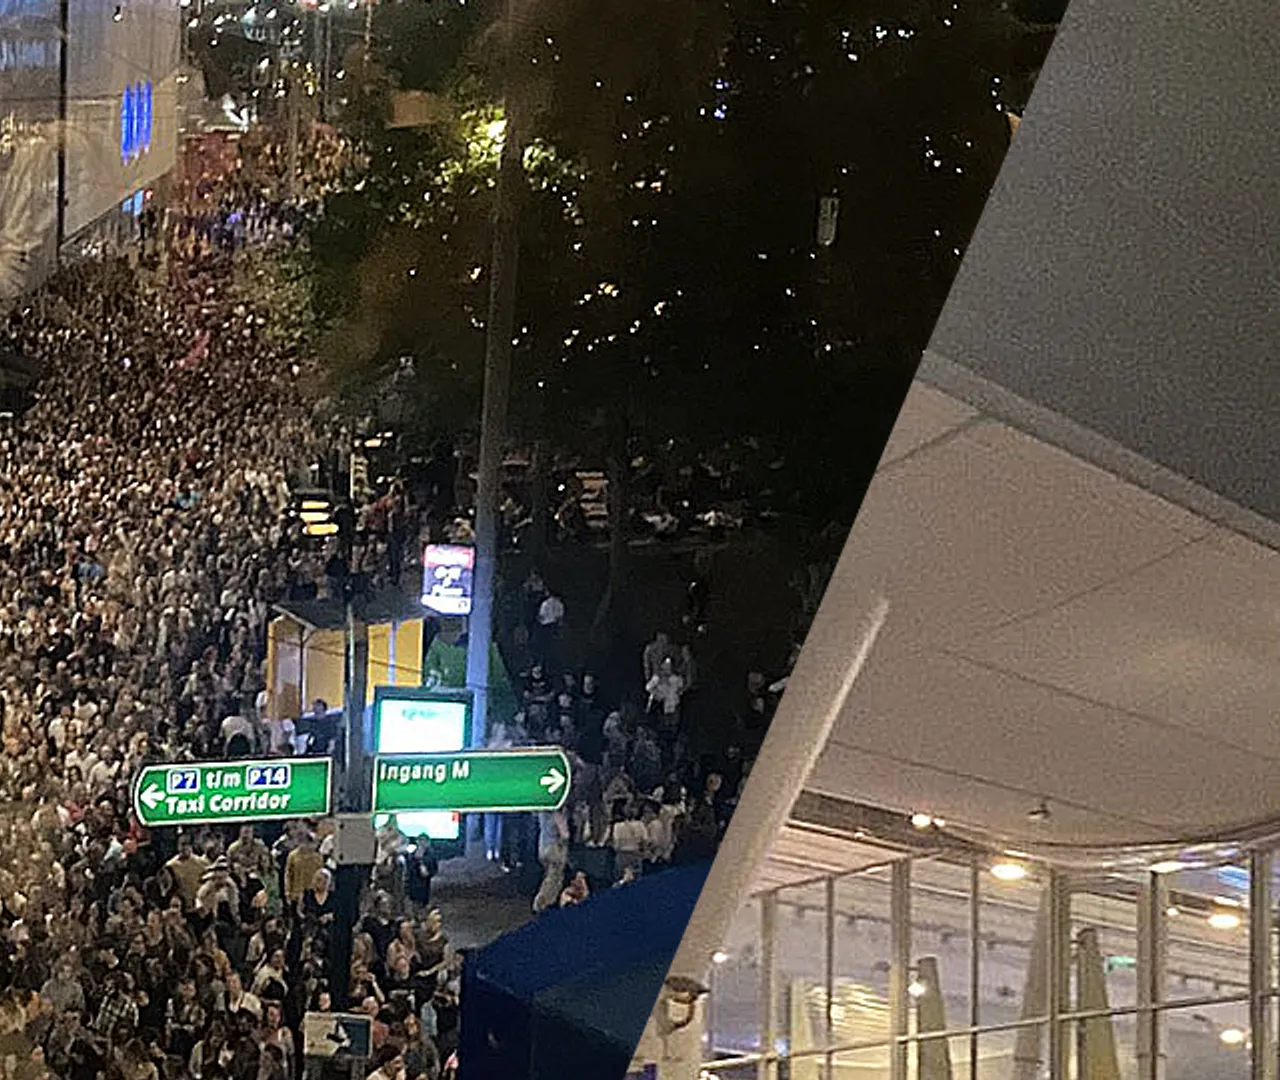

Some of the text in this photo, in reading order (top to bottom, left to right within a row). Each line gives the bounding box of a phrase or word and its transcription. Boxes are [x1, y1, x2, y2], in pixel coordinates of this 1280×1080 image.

[170, 765, 289, 791] P7 t/m P14
[379, 760, 470, 784] Ingang M
[166, 792, 291, 815] Taxi Corridor
